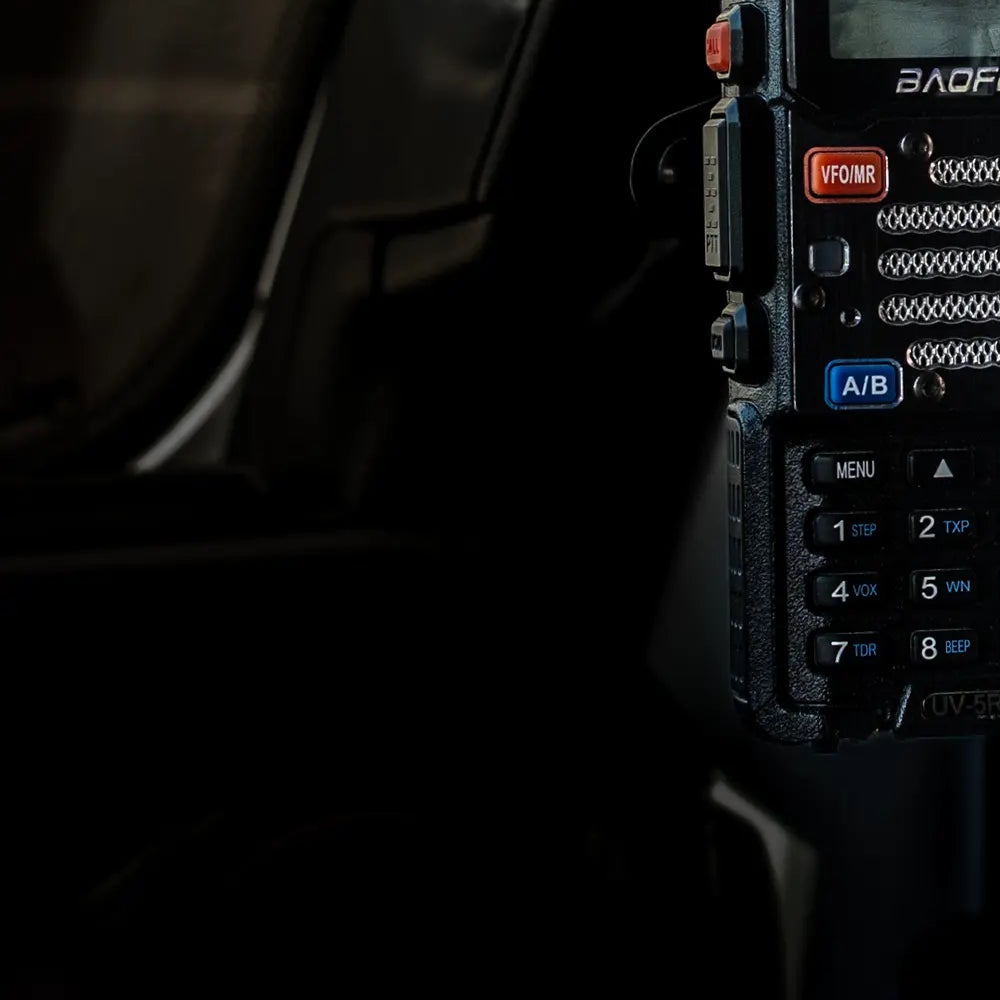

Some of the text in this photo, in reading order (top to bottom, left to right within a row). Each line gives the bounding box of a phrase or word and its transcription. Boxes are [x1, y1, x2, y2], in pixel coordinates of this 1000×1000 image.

[820, 164, 877, 185] VFO/MR
[842, 375, 888, 396] A/B
[836, 460, 875, 479] MENU
[831, 518, 877, 543] 1 STEP
[919, 515, 970, 538] 2 TXP
[831, 580, 878, 602] 4 VOX
[921, 576, 971, 600] 5 WN
[830, 641, 877, 663] 7 TDR
[921, 636, 971, 660] 8 BEEP
